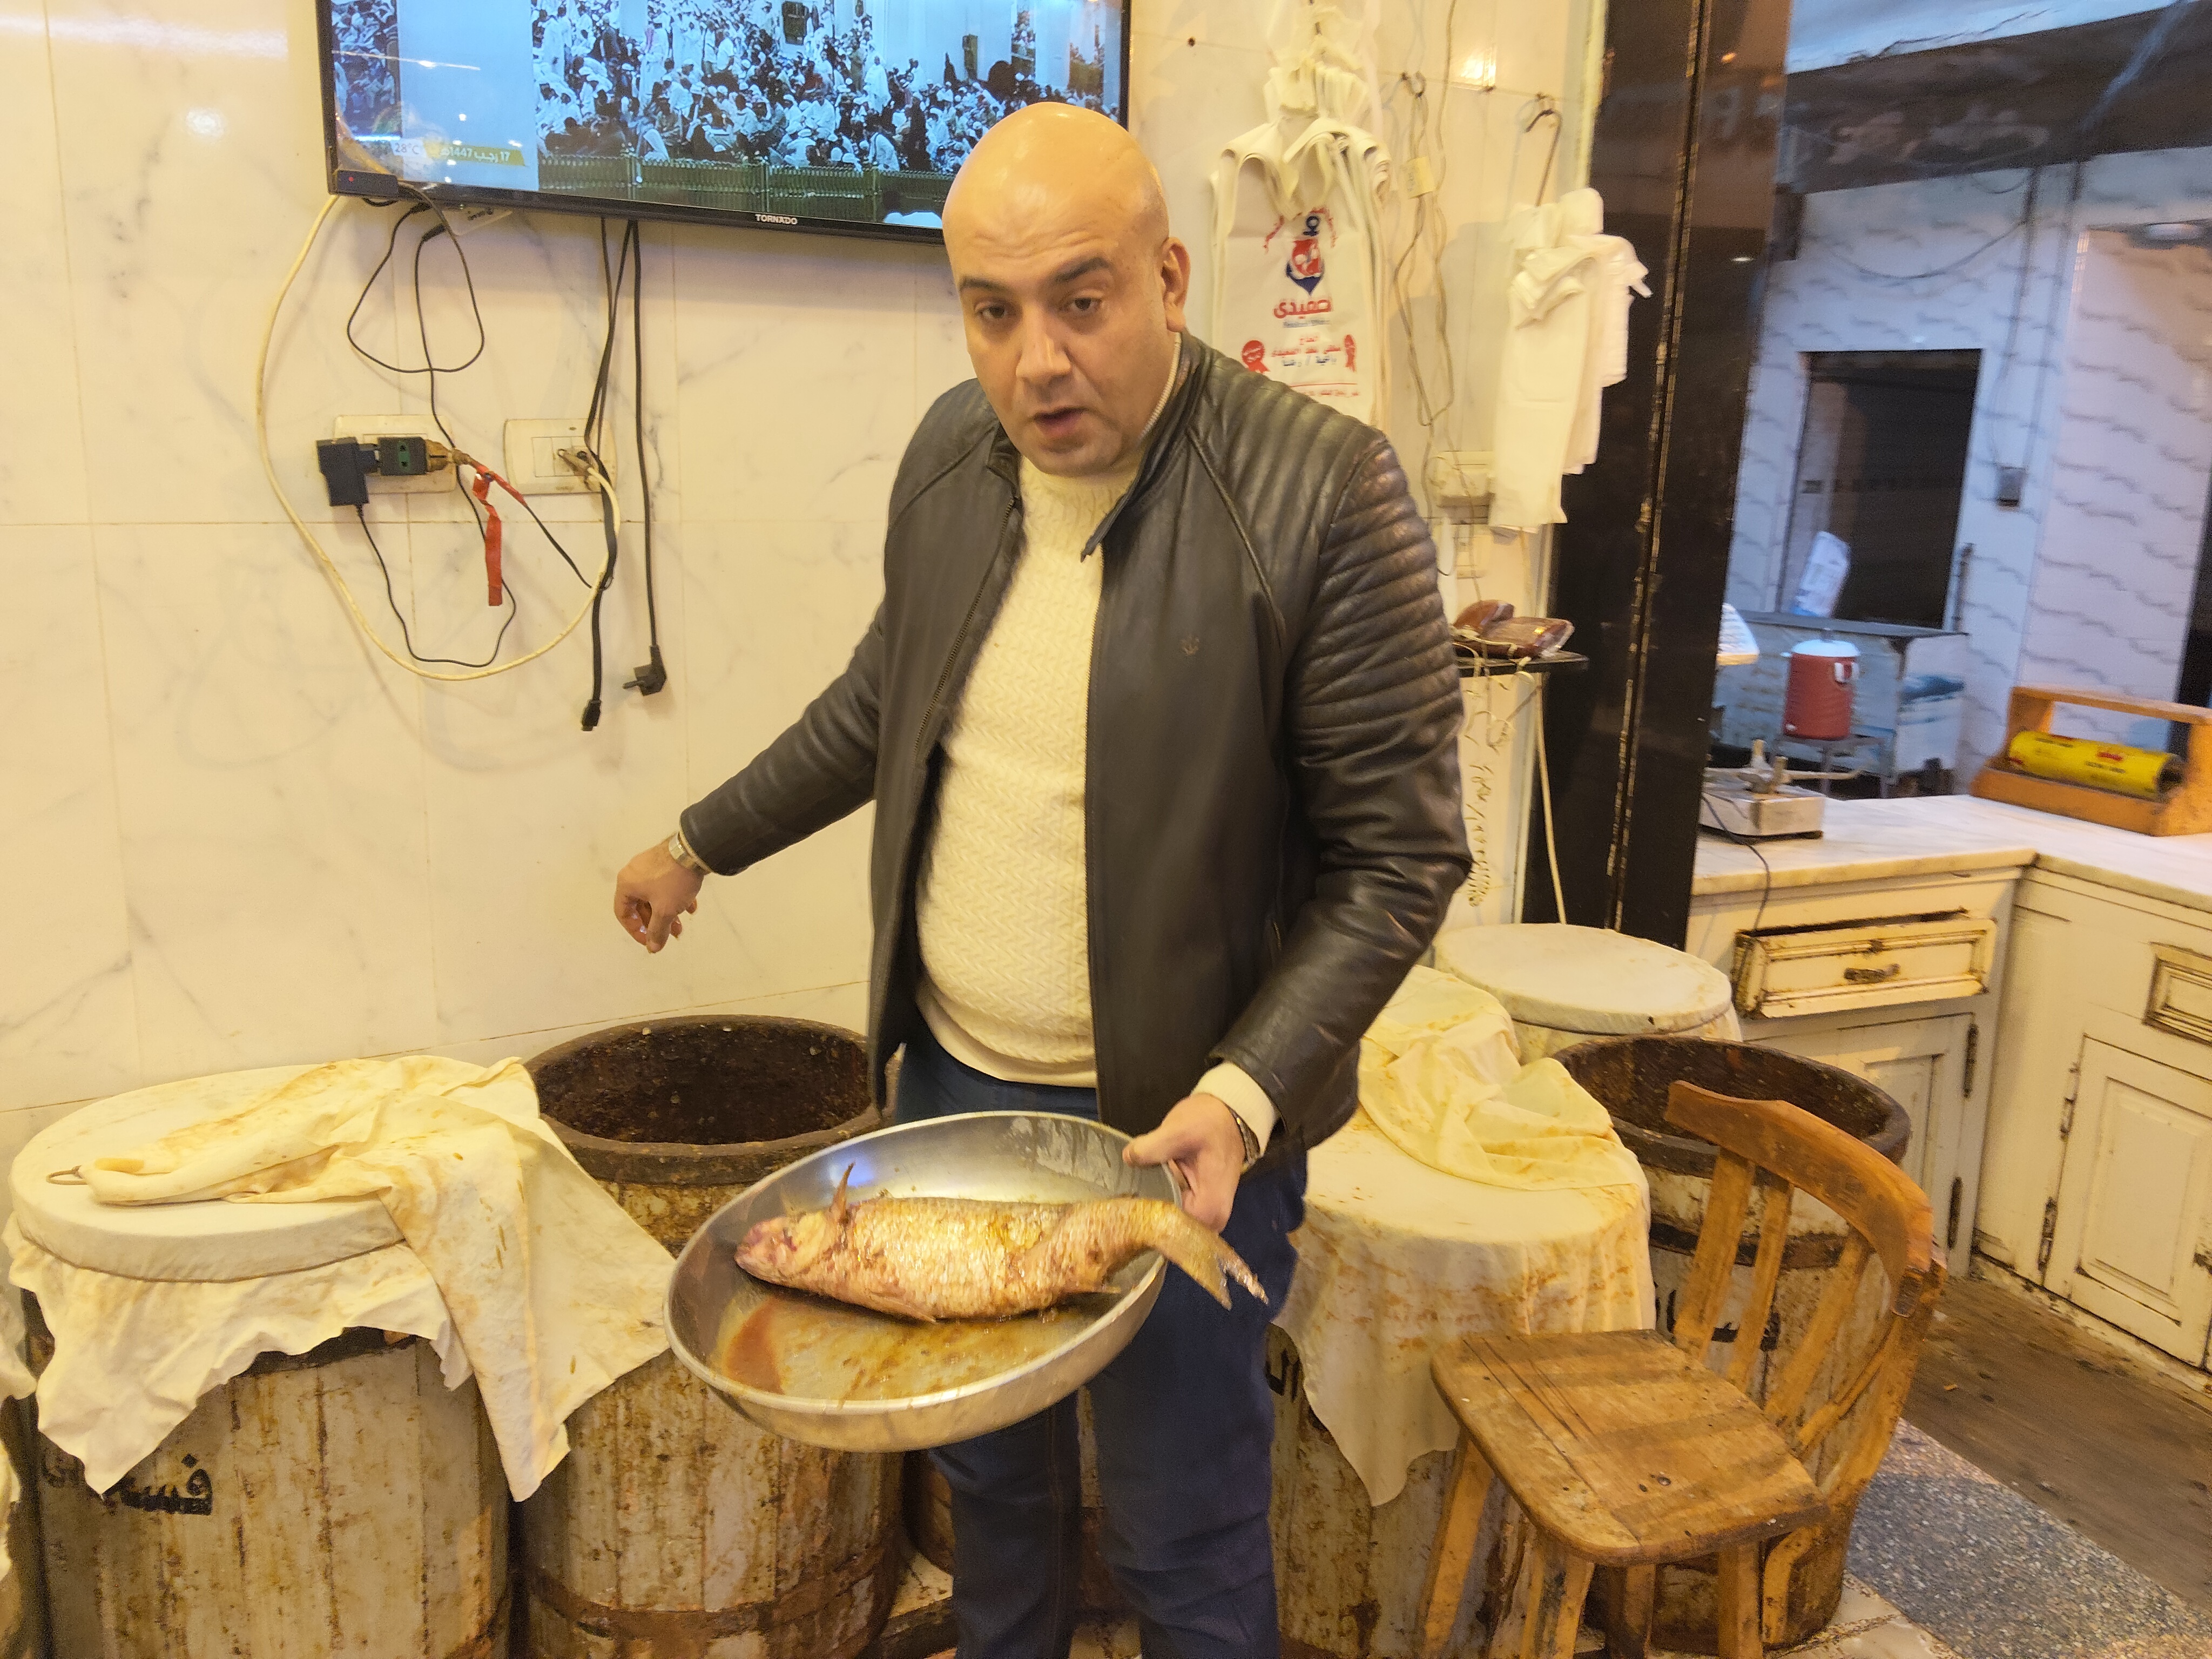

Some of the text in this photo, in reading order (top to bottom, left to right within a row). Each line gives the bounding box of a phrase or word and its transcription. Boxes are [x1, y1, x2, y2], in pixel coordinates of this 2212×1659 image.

[395, 142, 419, 154] 28°C
[474, 151, 498, 163] رجب
[500, 151, 510, 161] 17
[755, 214, 798, 225] TORNADO
